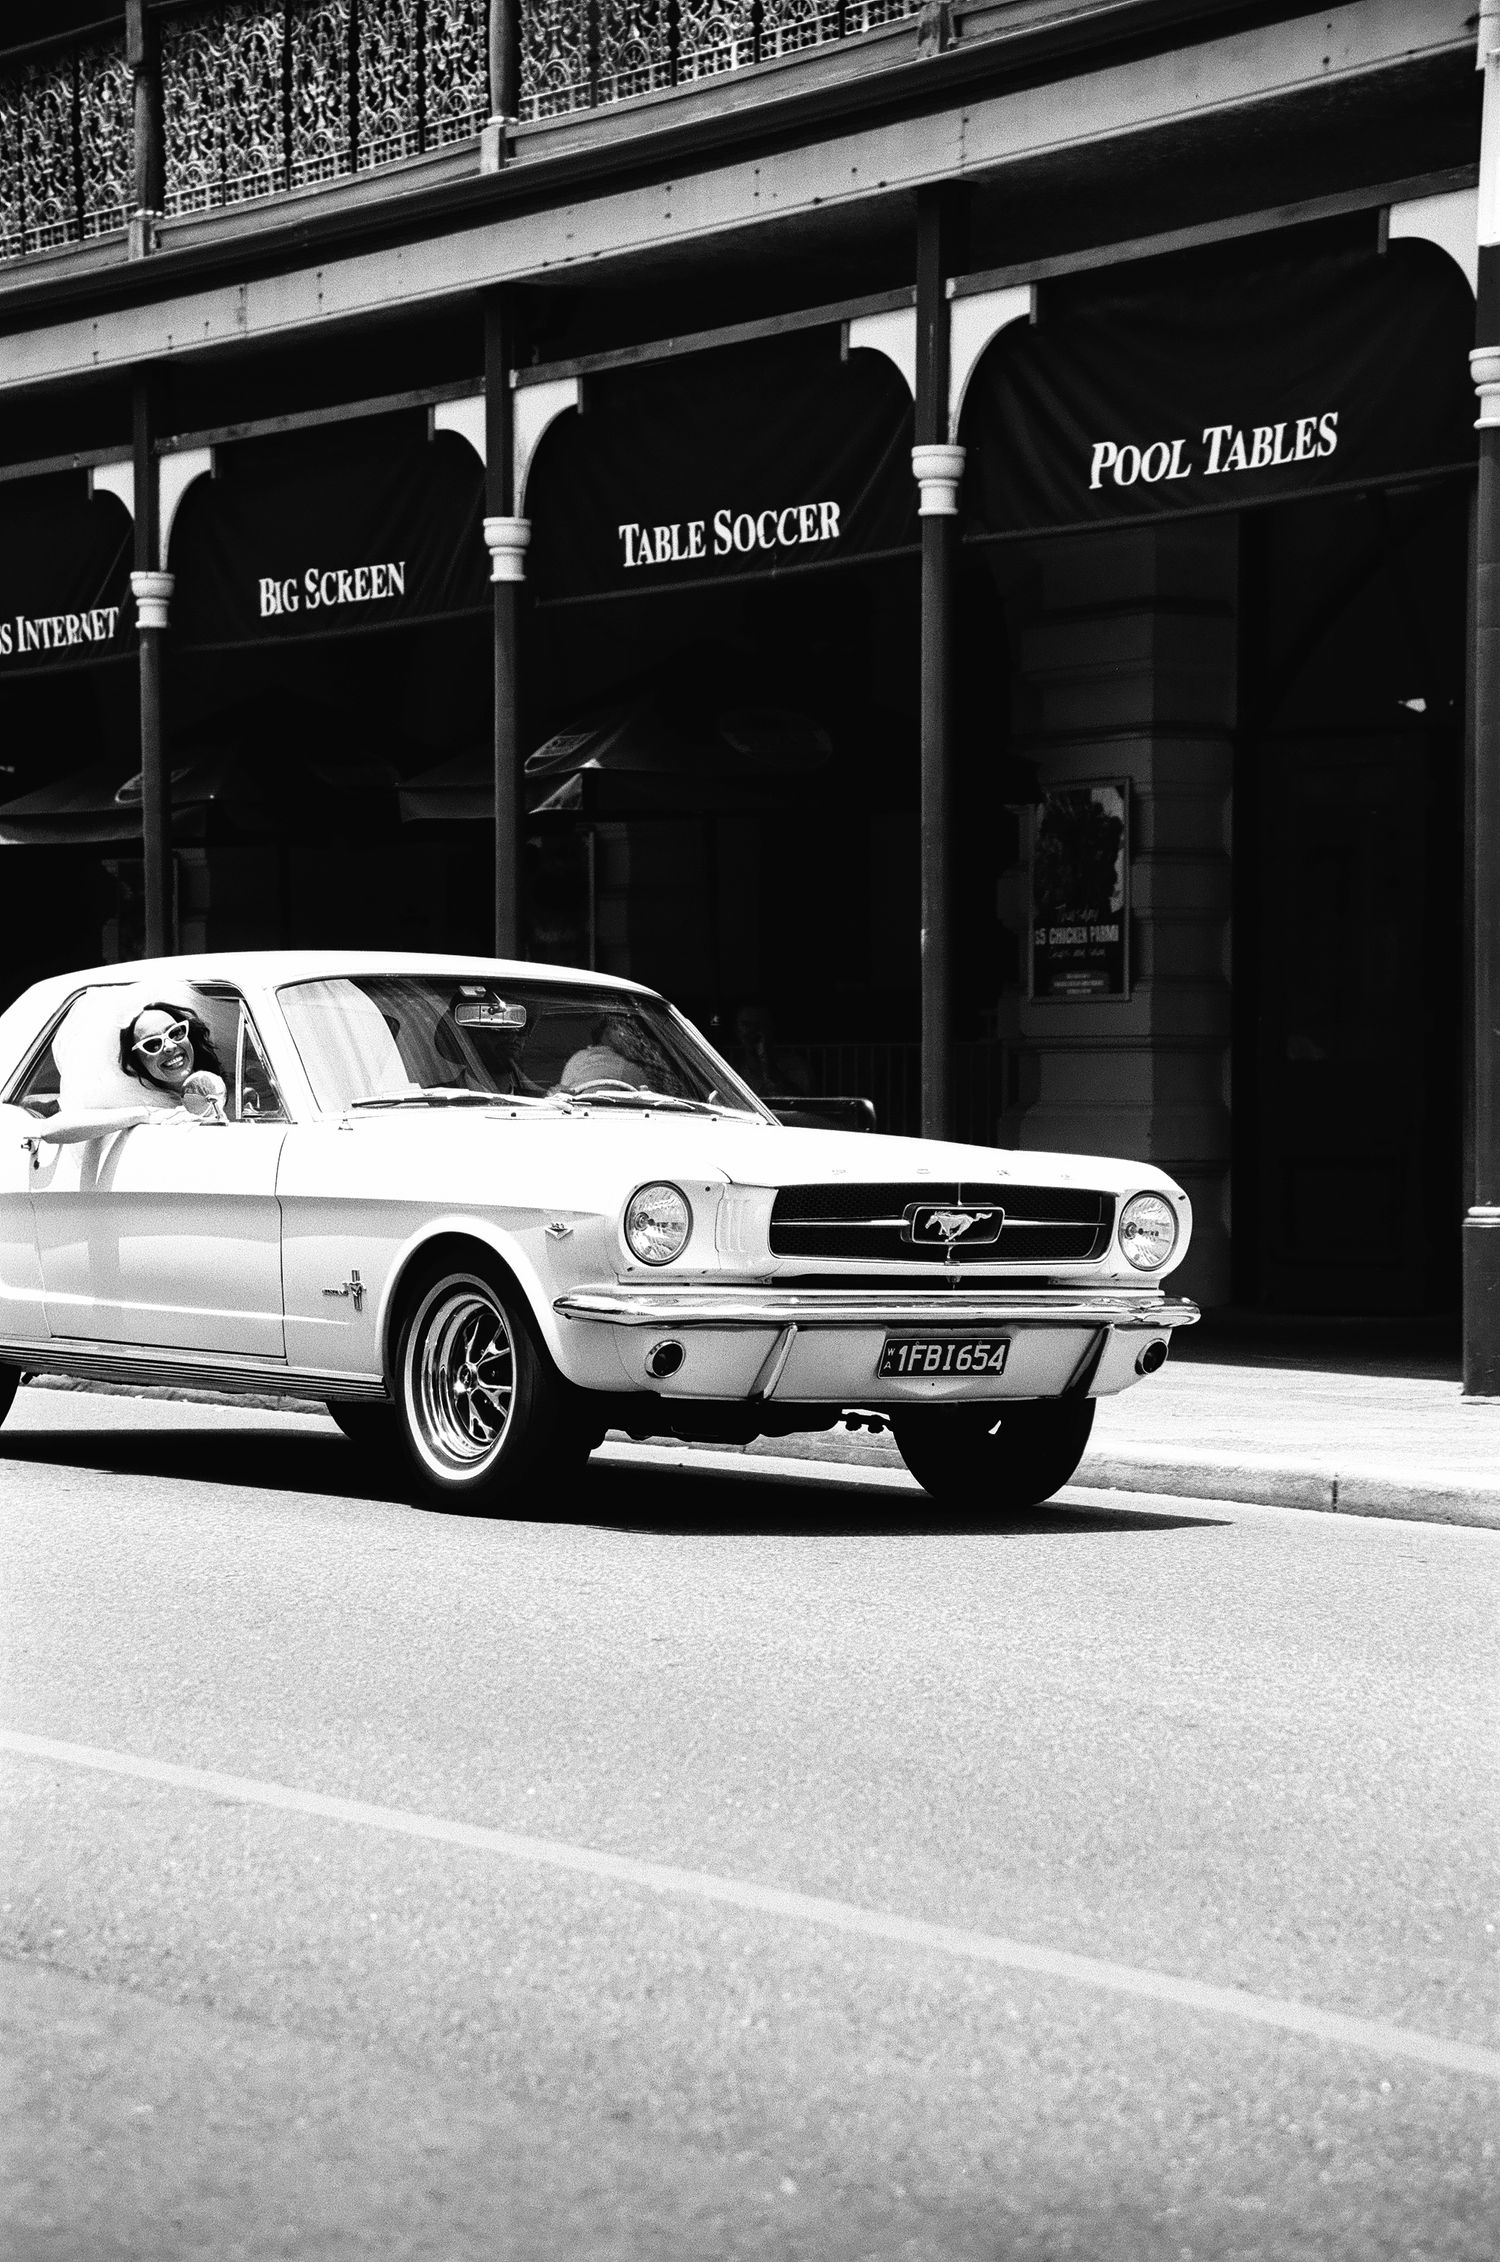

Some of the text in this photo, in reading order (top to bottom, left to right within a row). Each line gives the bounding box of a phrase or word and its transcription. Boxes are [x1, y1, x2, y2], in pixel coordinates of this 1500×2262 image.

[1088, 411, 1339, 490] POOL TABLES
[618, 501, 841, 568] TABLE SOCCER
[258, 561, 406, 617] BIG SCREEN
[0, 606, 120, 655] S INTERNET
[898, 1345, 1006, 1371] 1FBI654
